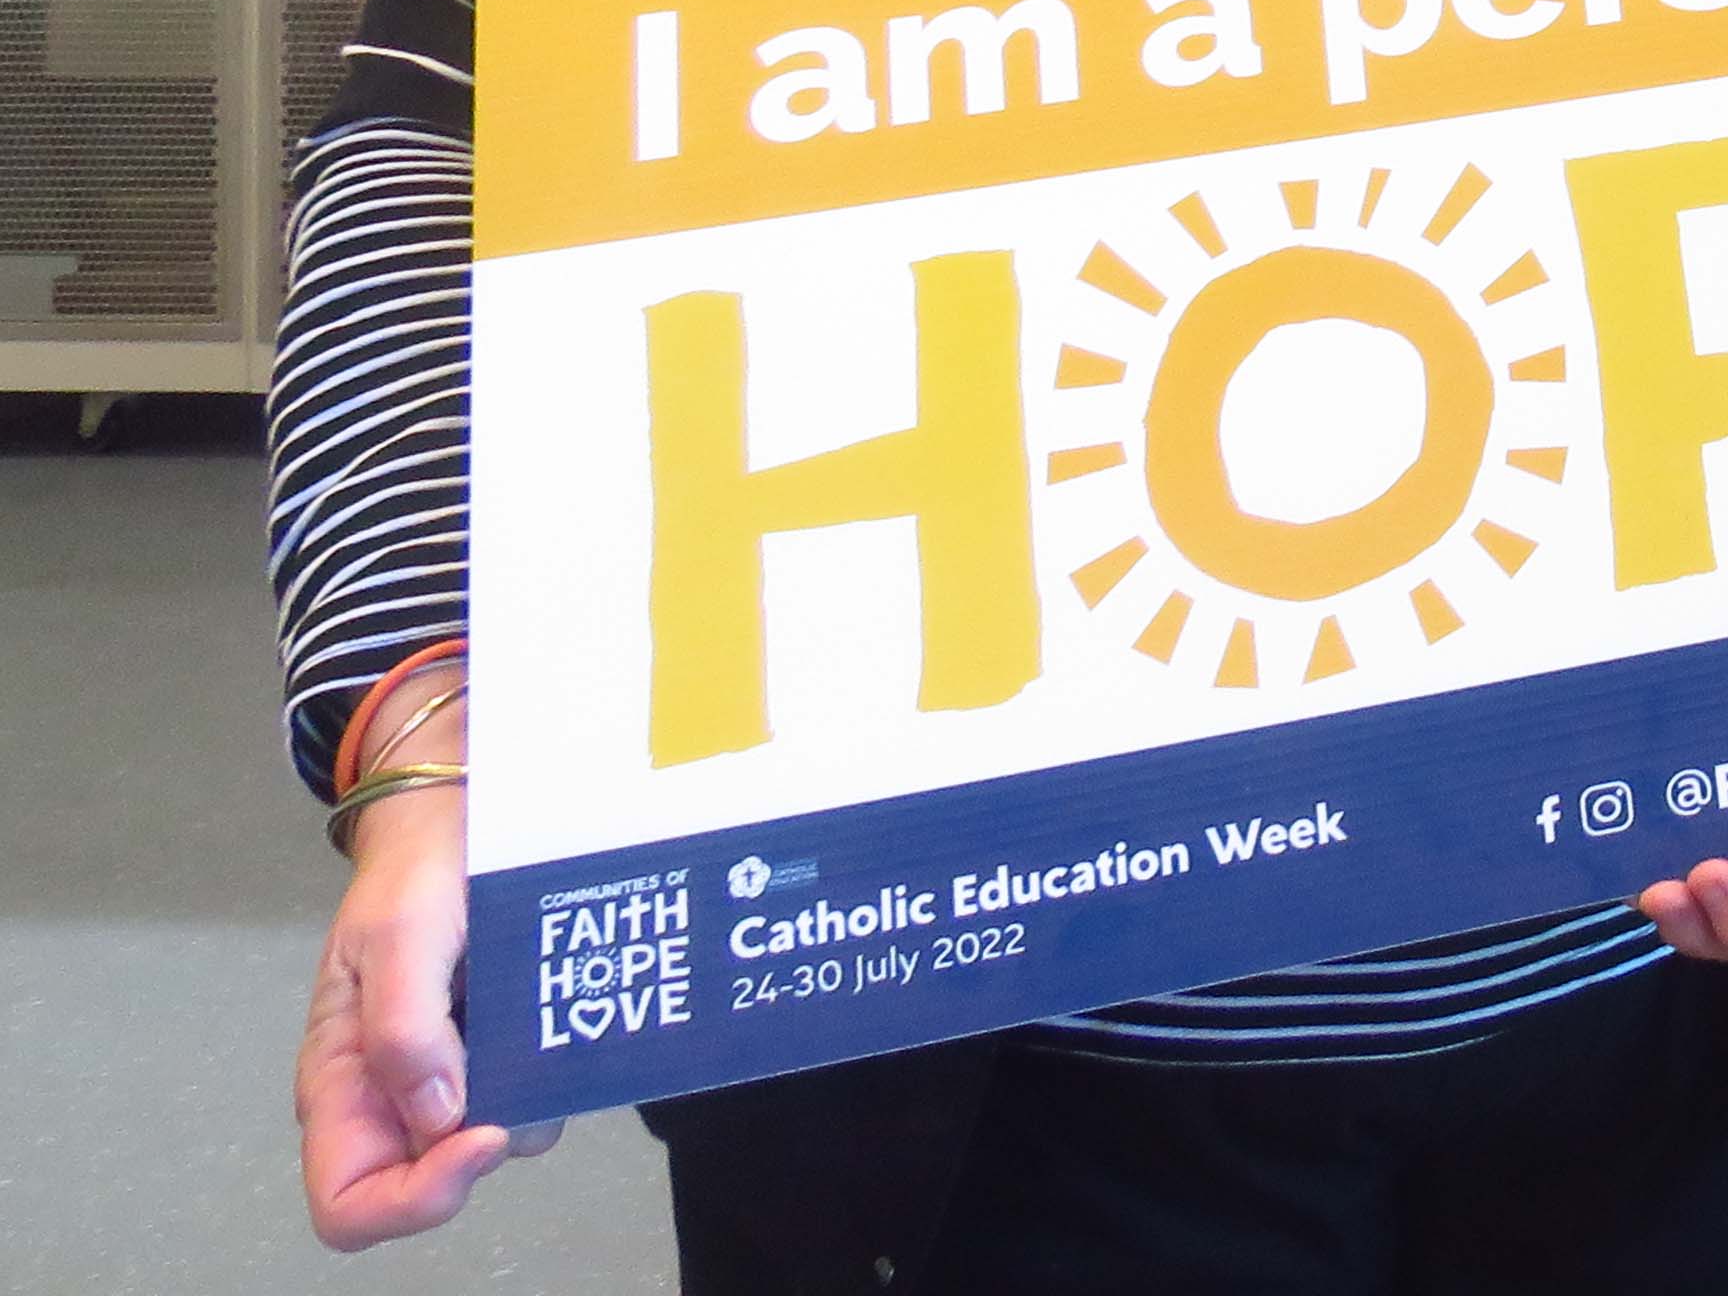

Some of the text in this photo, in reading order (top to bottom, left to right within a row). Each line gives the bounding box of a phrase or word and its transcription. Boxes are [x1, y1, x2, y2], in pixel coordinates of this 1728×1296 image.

[634, 10, 679, 162] I
[539, 867, 691, 910] COMMUNITIES OF
[729, 802, 1348, 959] Catholic Education Week
[540, 888, 689, 957] FAITH
[539, 935, 691, 1004] HOPE
[732, 922, 1027, 1011] 24-30 July 2022
[540, 980, 691, 1050] LOVE
